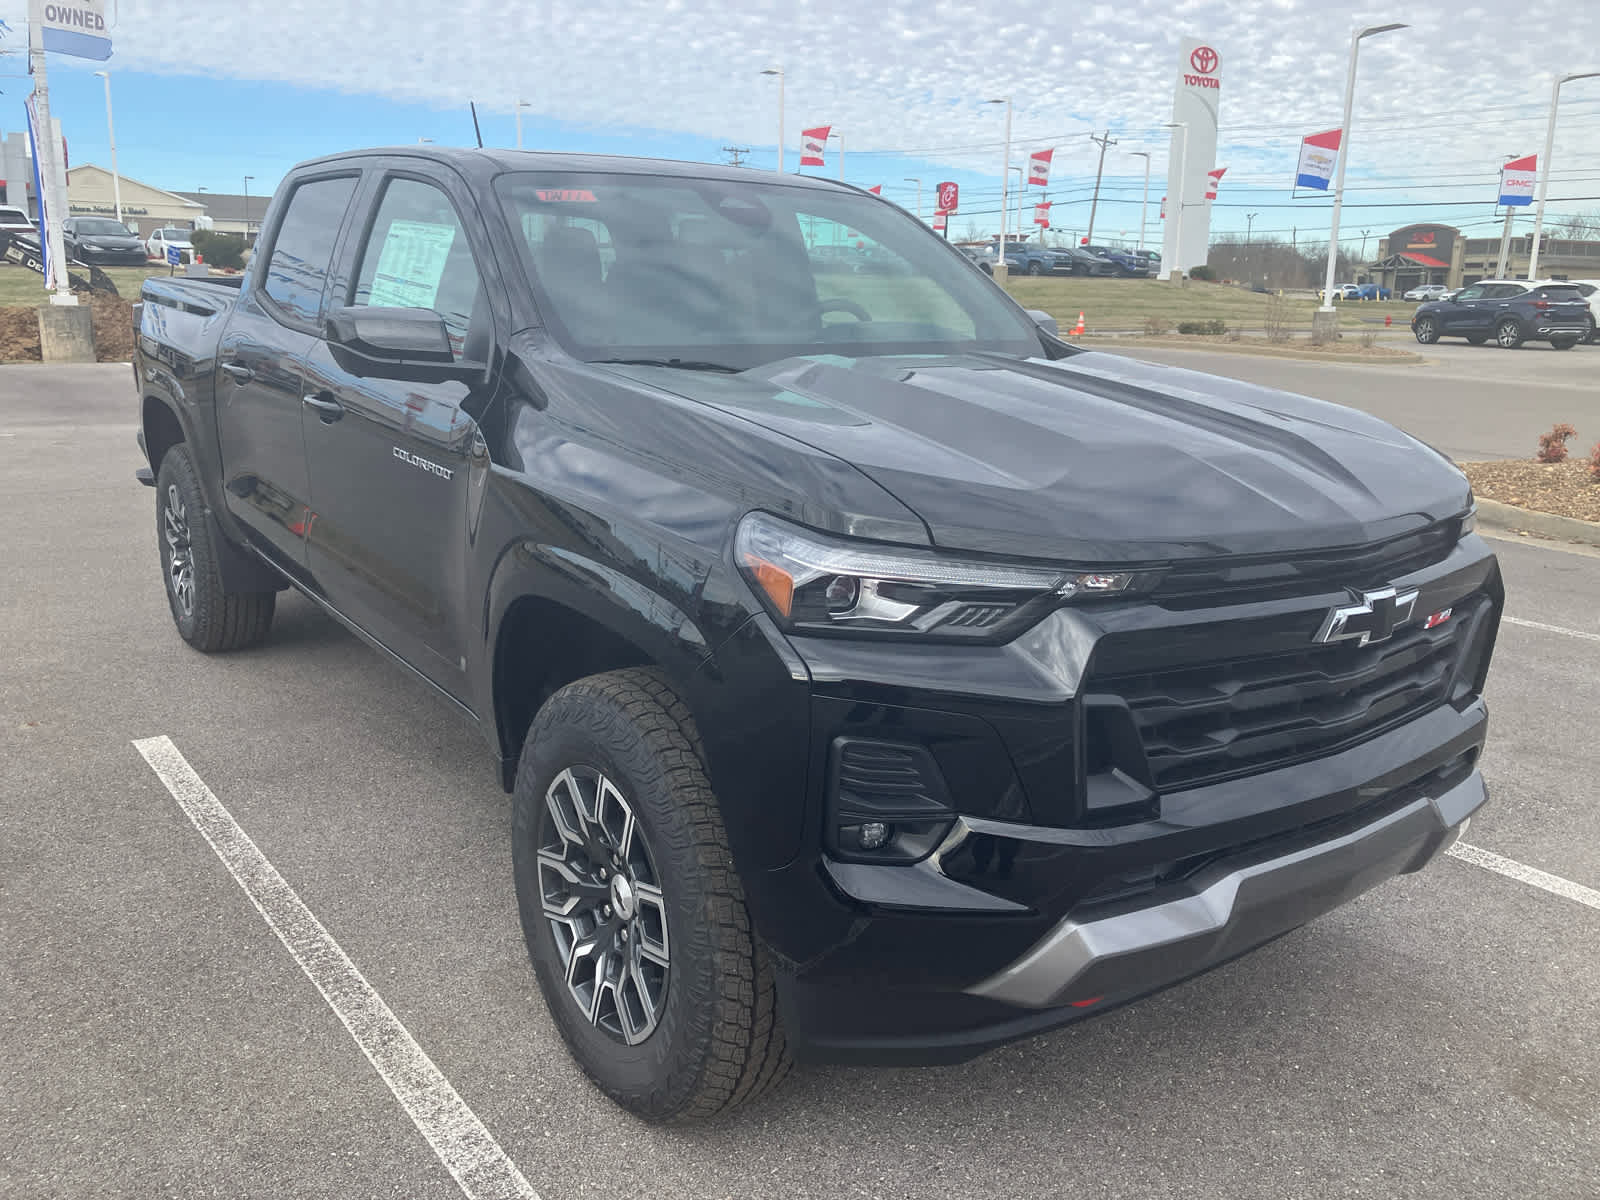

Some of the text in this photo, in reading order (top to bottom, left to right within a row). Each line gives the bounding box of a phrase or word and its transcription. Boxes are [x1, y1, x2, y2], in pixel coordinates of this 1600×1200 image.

[45, 4, 105, 31] OWNED
[1183, 74, 1220, 88] TOYOTA
[392, 446, 455, 481] COLORADO
